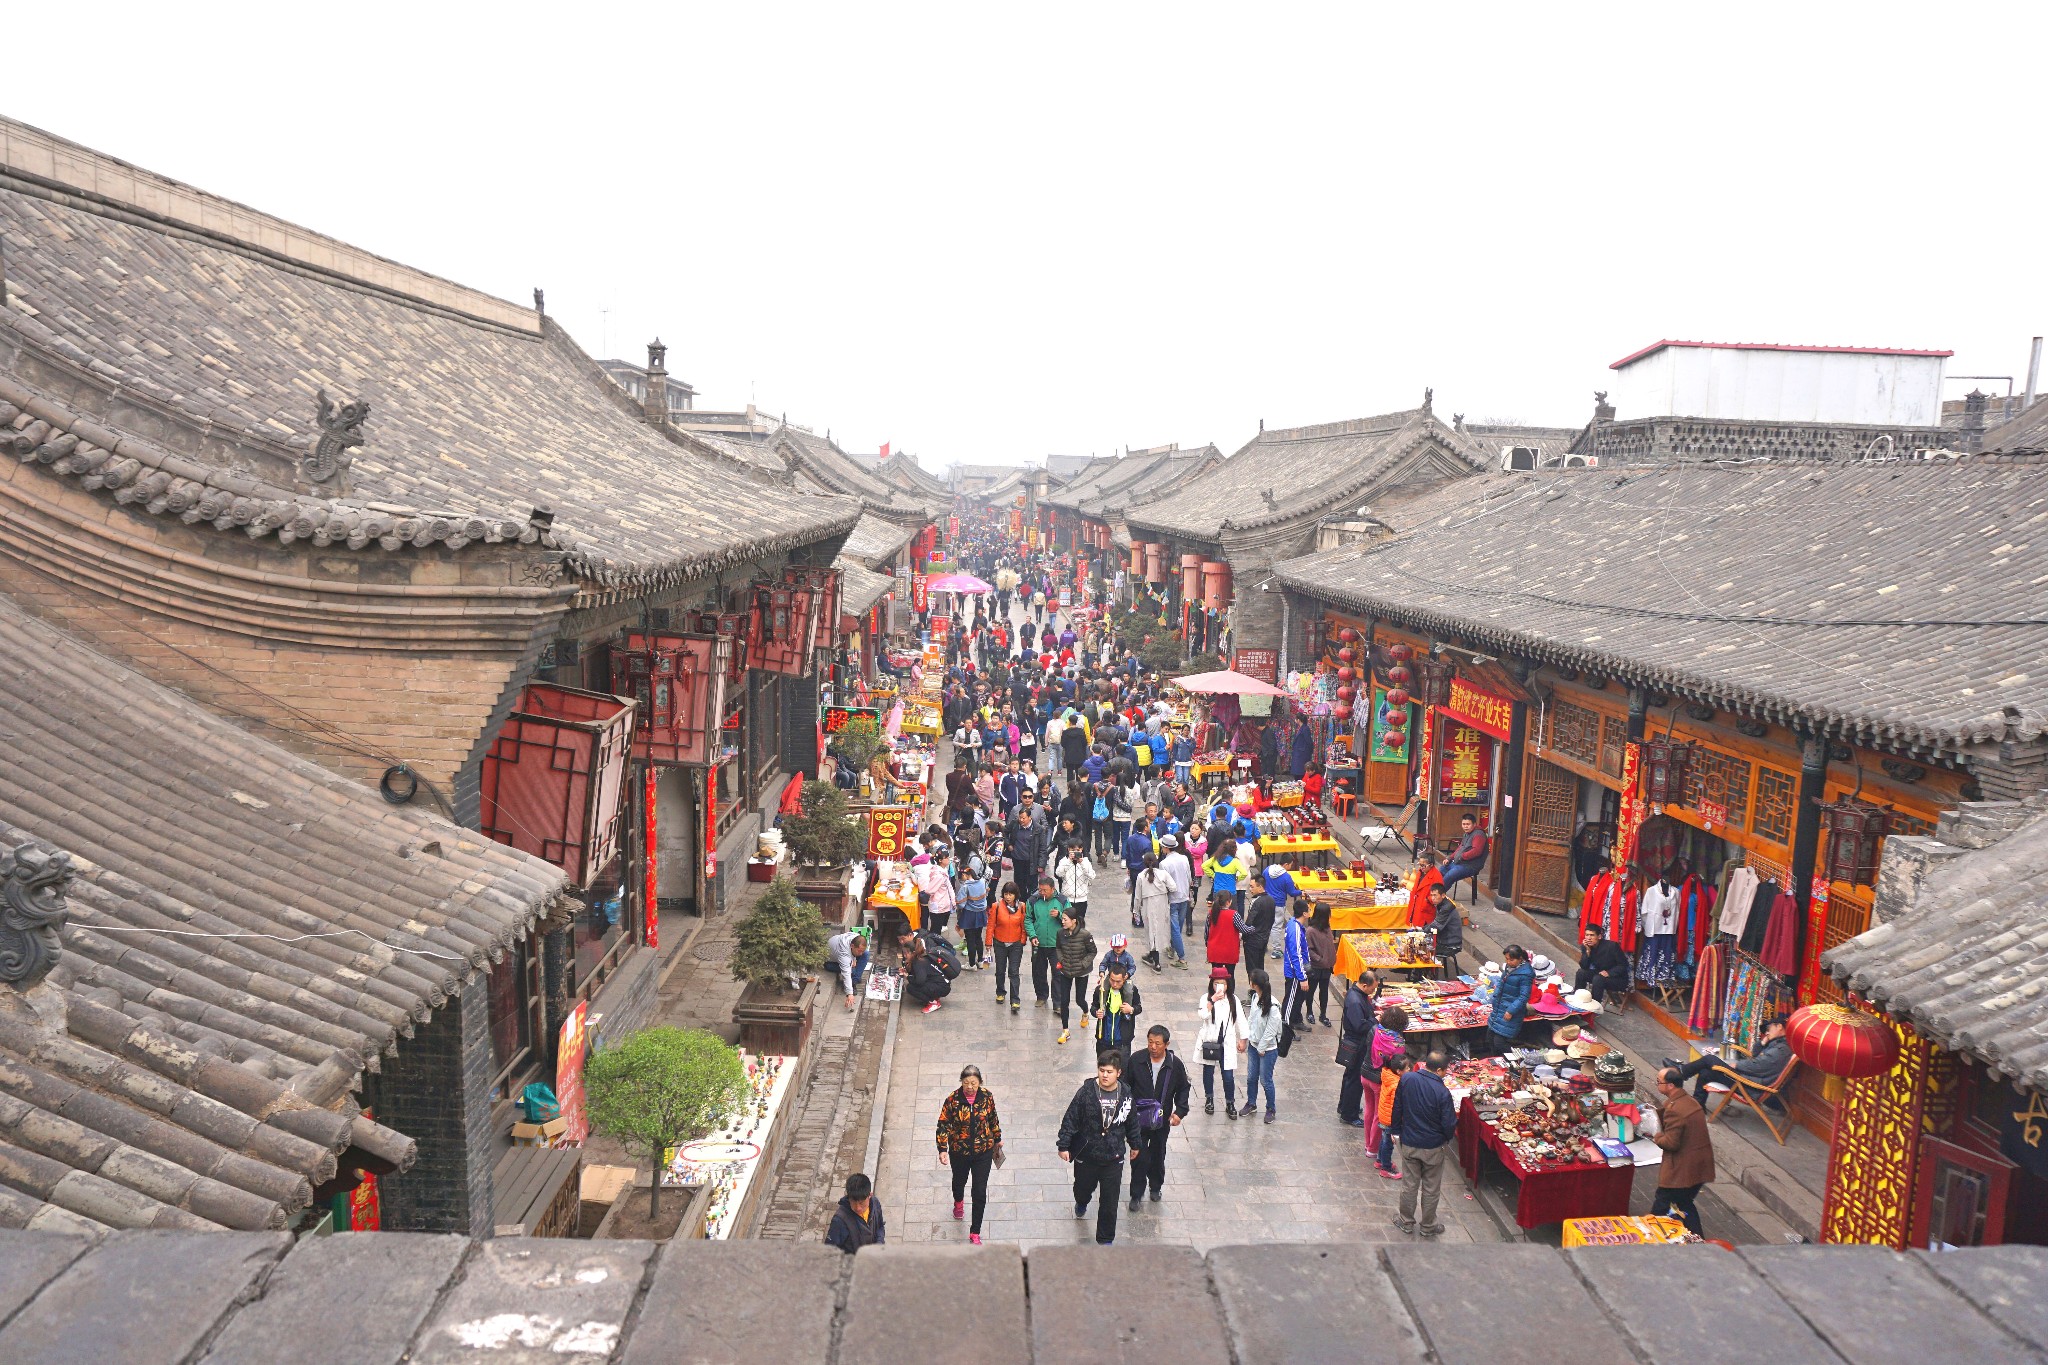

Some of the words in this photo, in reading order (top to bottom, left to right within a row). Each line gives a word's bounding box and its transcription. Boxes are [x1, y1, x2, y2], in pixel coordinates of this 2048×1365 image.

[1451, 727, 1481, 798] 推光漆器
[880, 824, 896, 851] 碗脱
